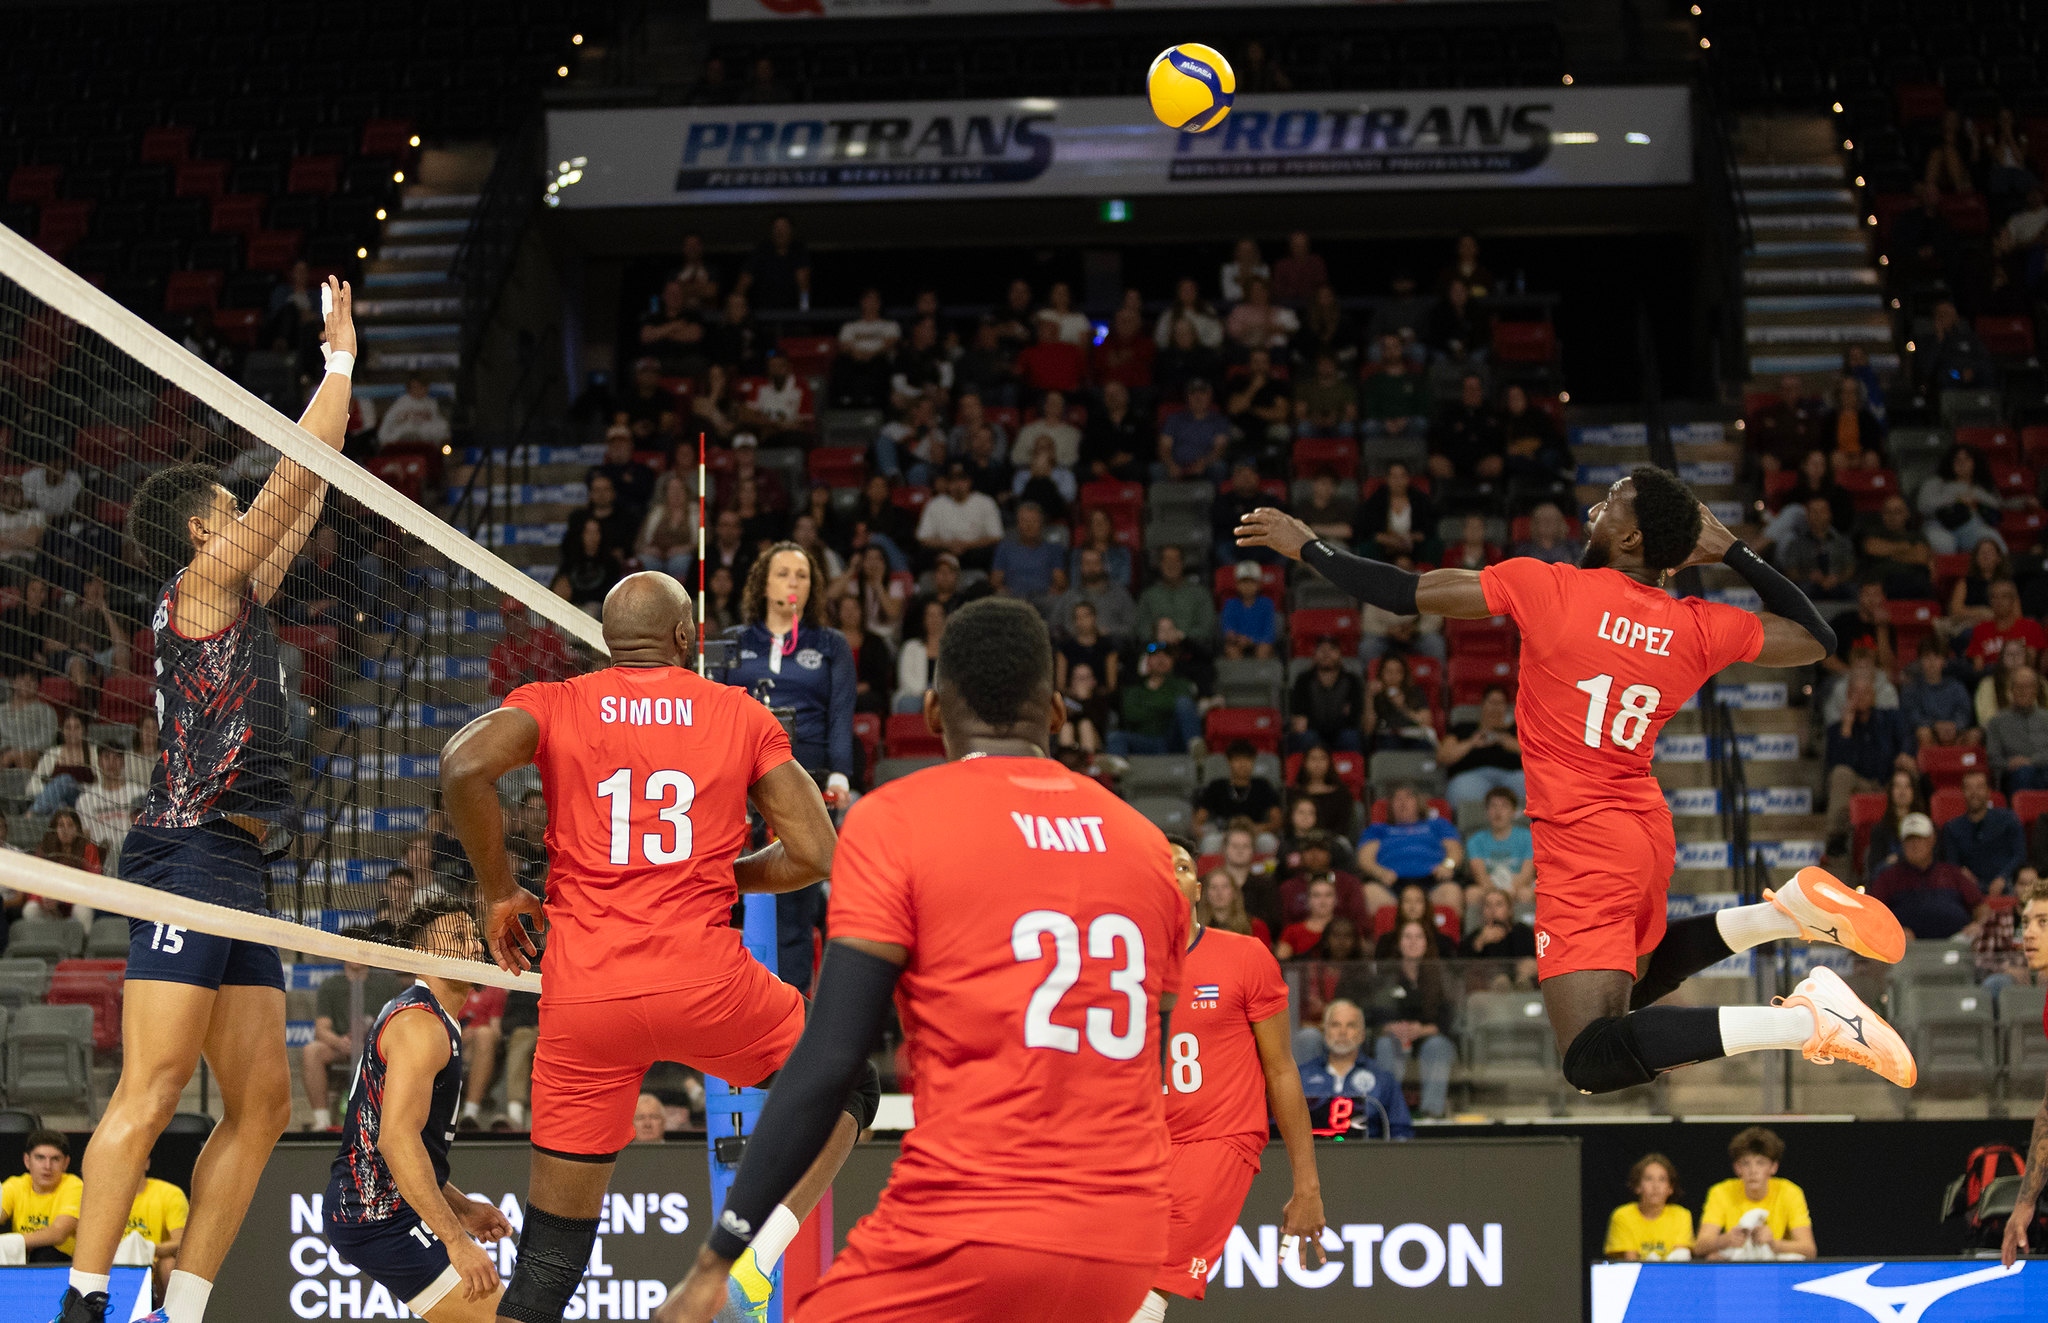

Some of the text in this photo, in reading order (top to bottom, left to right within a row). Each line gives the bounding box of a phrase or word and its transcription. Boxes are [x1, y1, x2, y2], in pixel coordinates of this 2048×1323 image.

[680, 114, 1056, 168] PROTRANS
[1597, 611, 1674, 656] LOPEZ
[600, 695, 693, 727] SIMON
[1576, 673, 1662, 751] 18
[597, 767, 696, 866] 13
[1010, 810, 1107, 853] YANT
[151, 920, 187, 954] 15
[1011, 909, 1148, 1061] 23
[1191, 1001, 1217, 1009] CUB
[1162, 1031, 1203, 1095] 8
[599, 1192, 690, 1235] EN'S
[1206, 1223, 1504, 1289] NCTON
